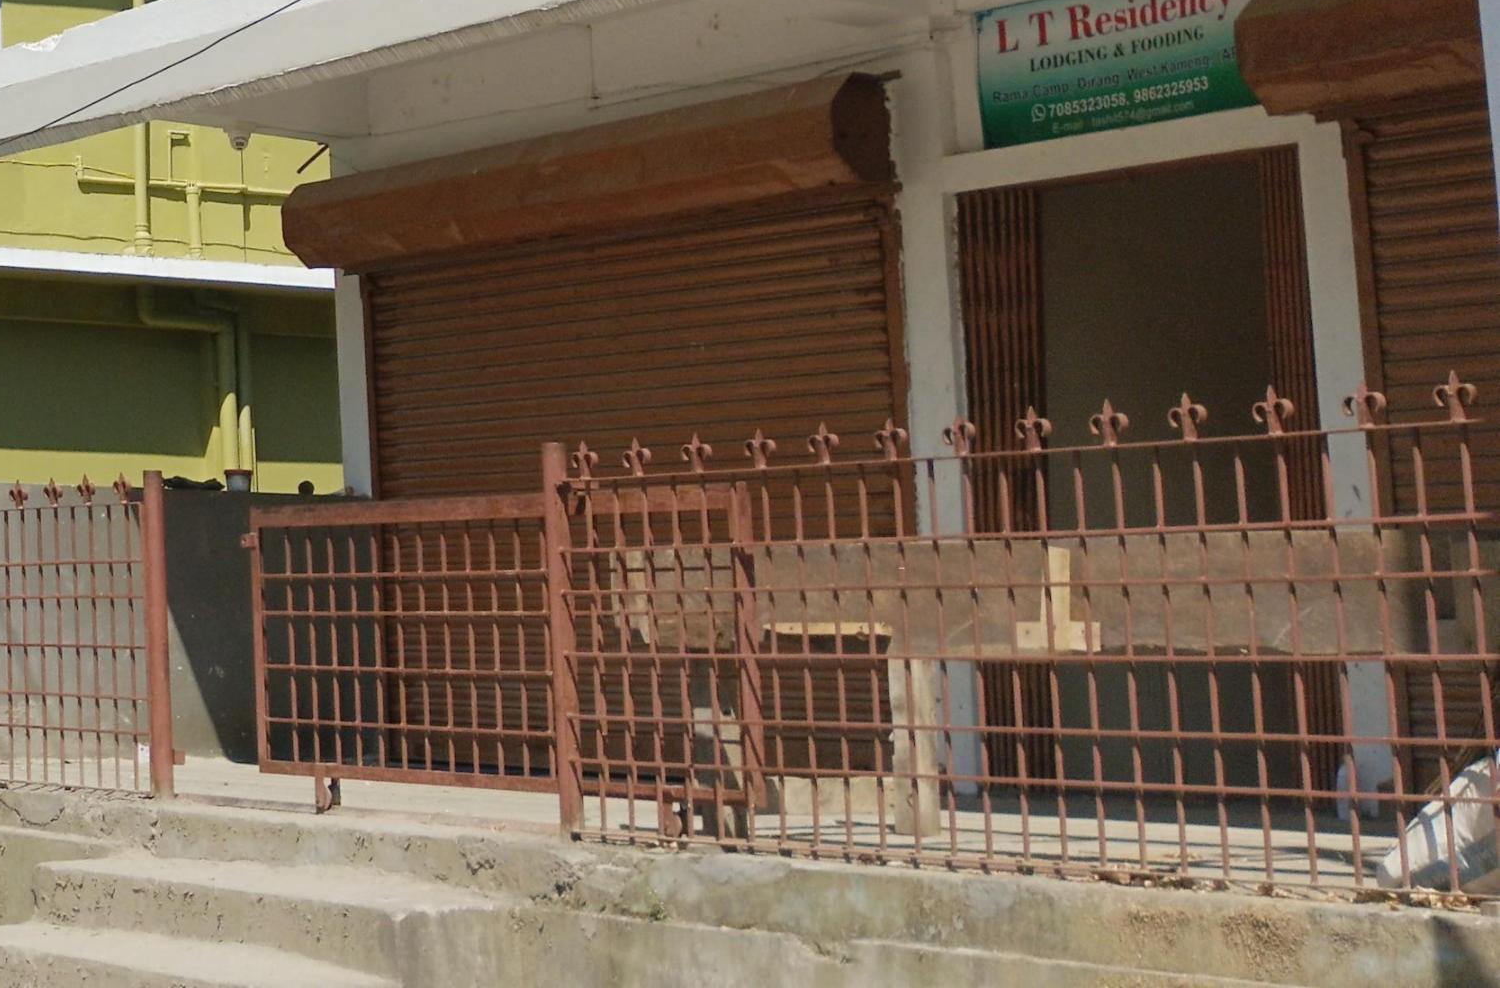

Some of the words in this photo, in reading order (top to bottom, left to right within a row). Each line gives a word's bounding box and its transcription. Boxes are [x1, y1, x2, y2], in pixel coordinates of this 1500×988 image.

[995, 19, 1019, 54] L
[1029, 10, 1054, 46] T
[1030, 48, 1108, 72] LODGING
[1113, 44, 1125, 58] &
[1132, 26, 1204, 54] FOODING
[993, 90, 1028, 103] Rama
[1127, 67, 1156, 81] West
